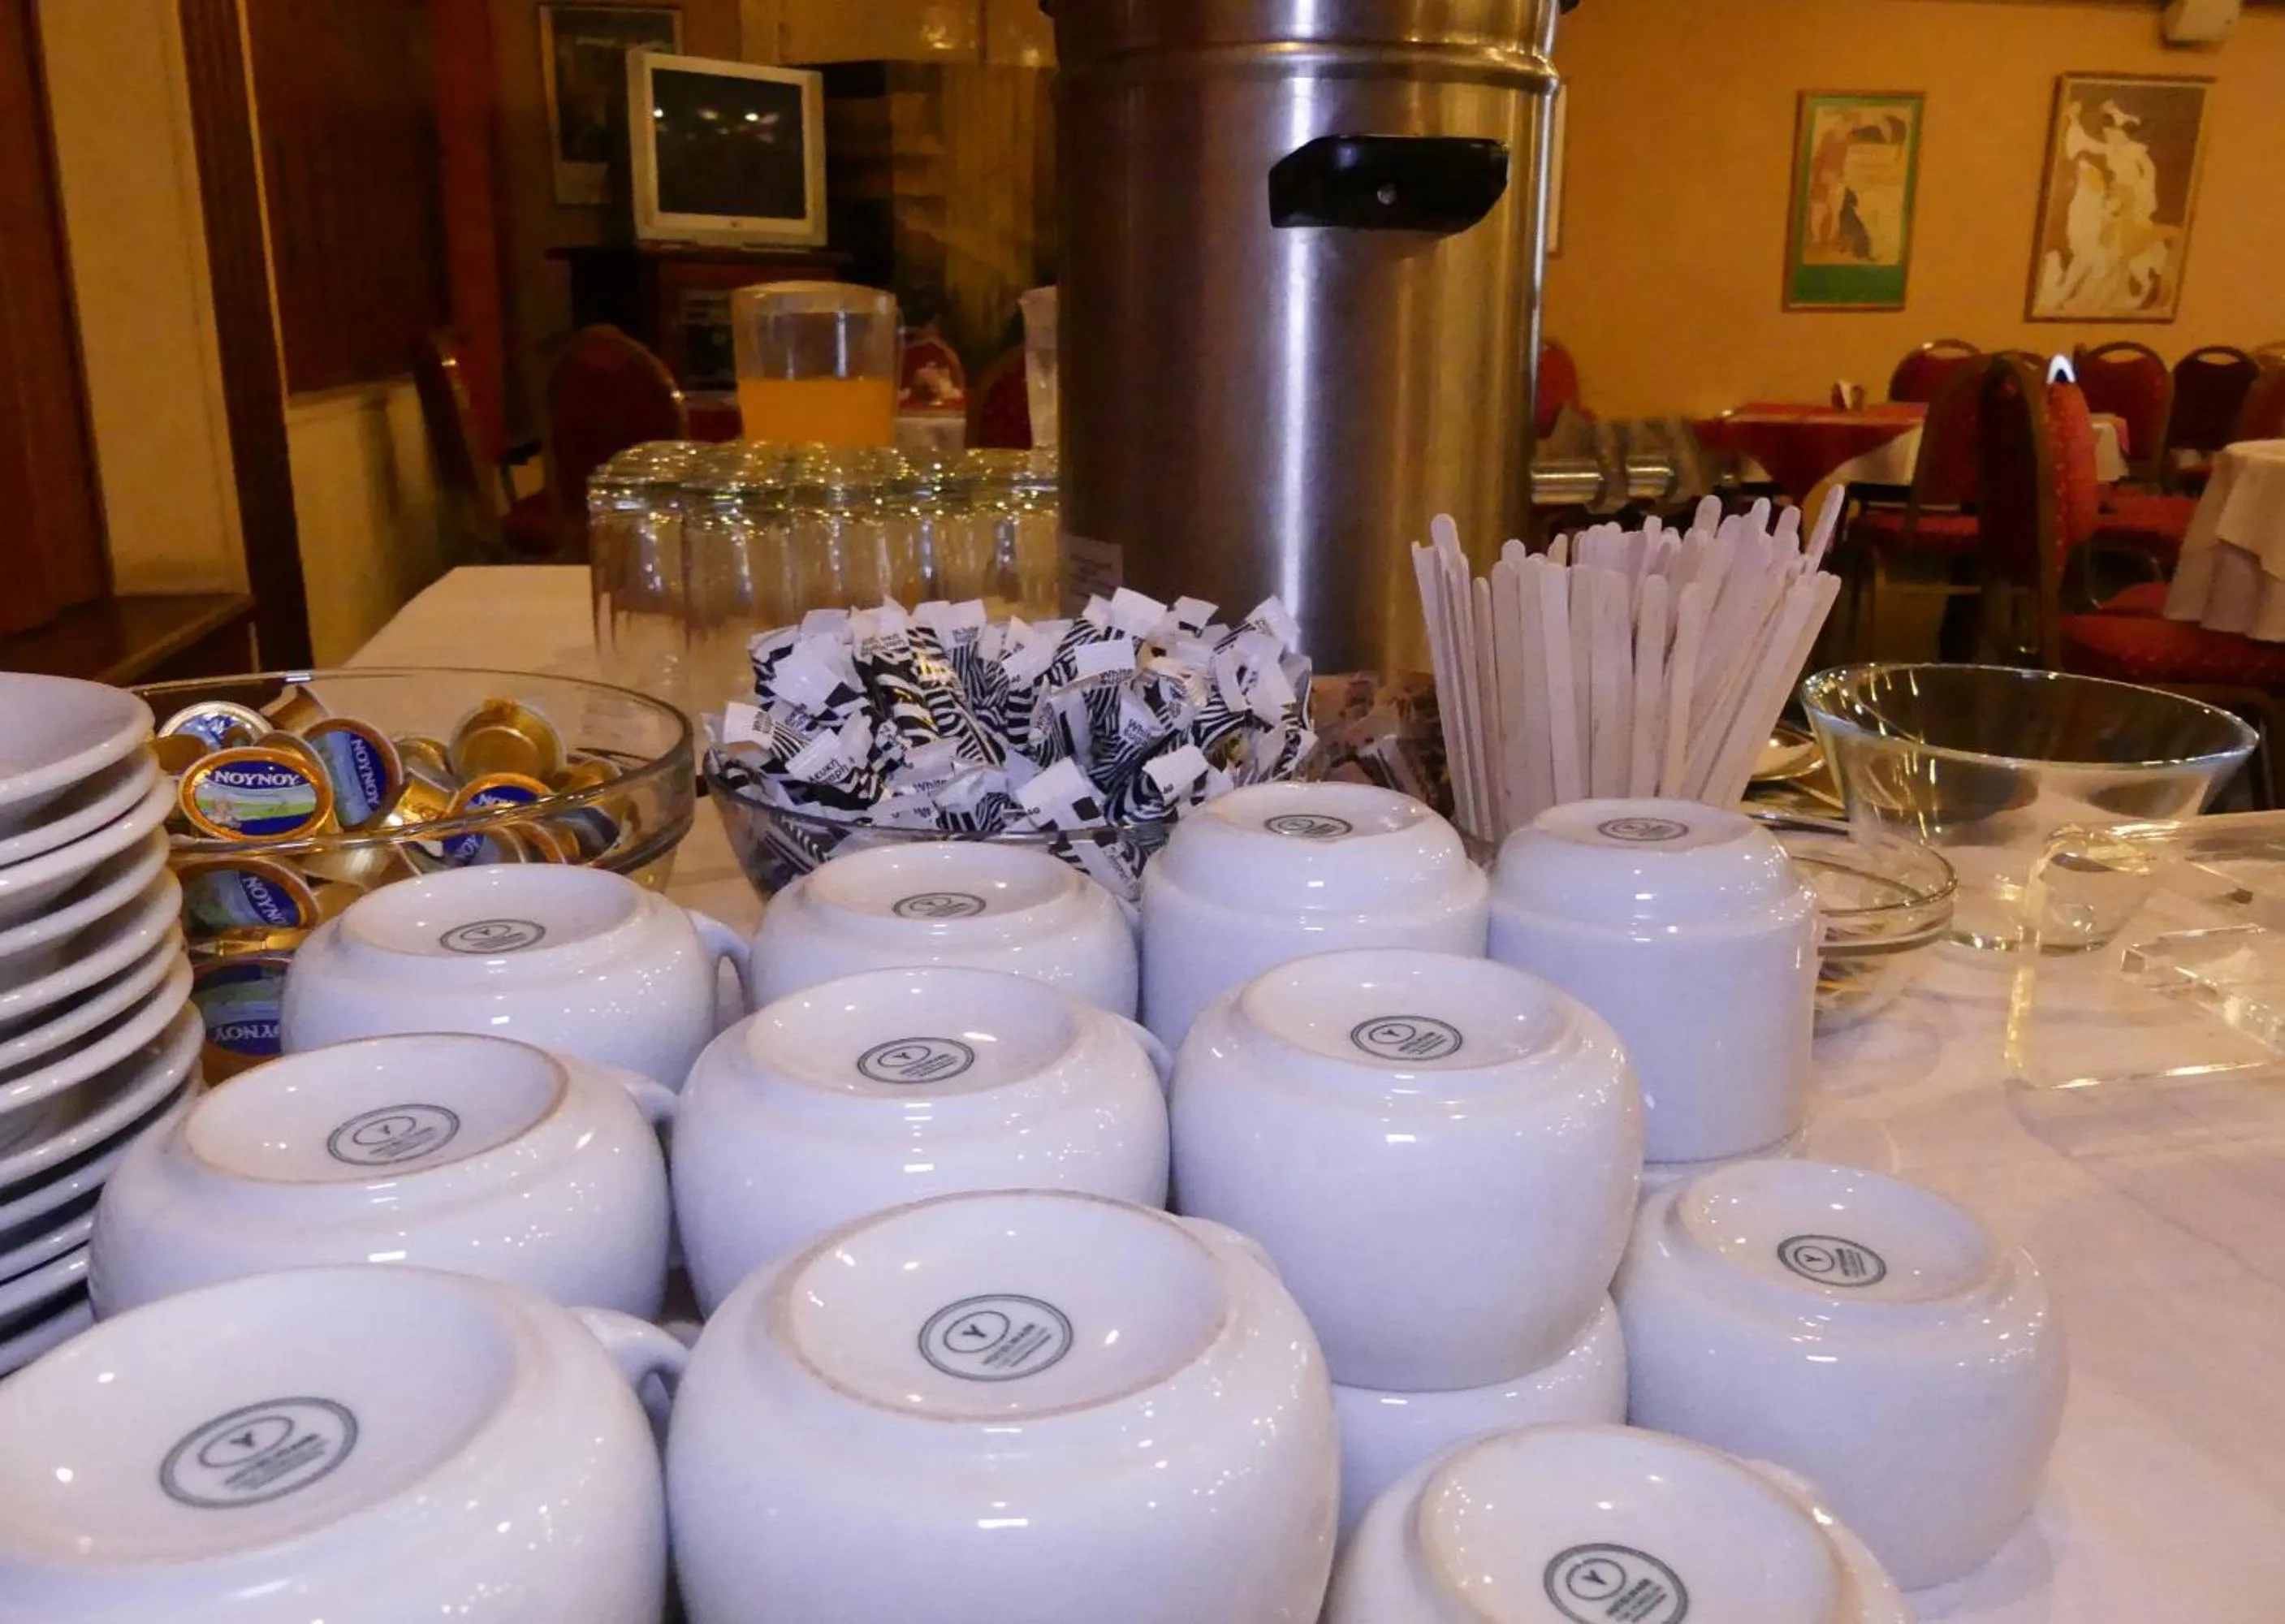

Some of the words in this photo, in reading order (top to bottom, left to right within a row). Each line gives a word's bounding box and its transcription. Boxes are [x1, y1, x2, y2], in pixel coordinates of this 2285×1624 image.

[214, 771, 301, 786] NOYNOY
[351, 739, 380, 804] NOYNOY
[242, 876, 287, 925] NOYNO
